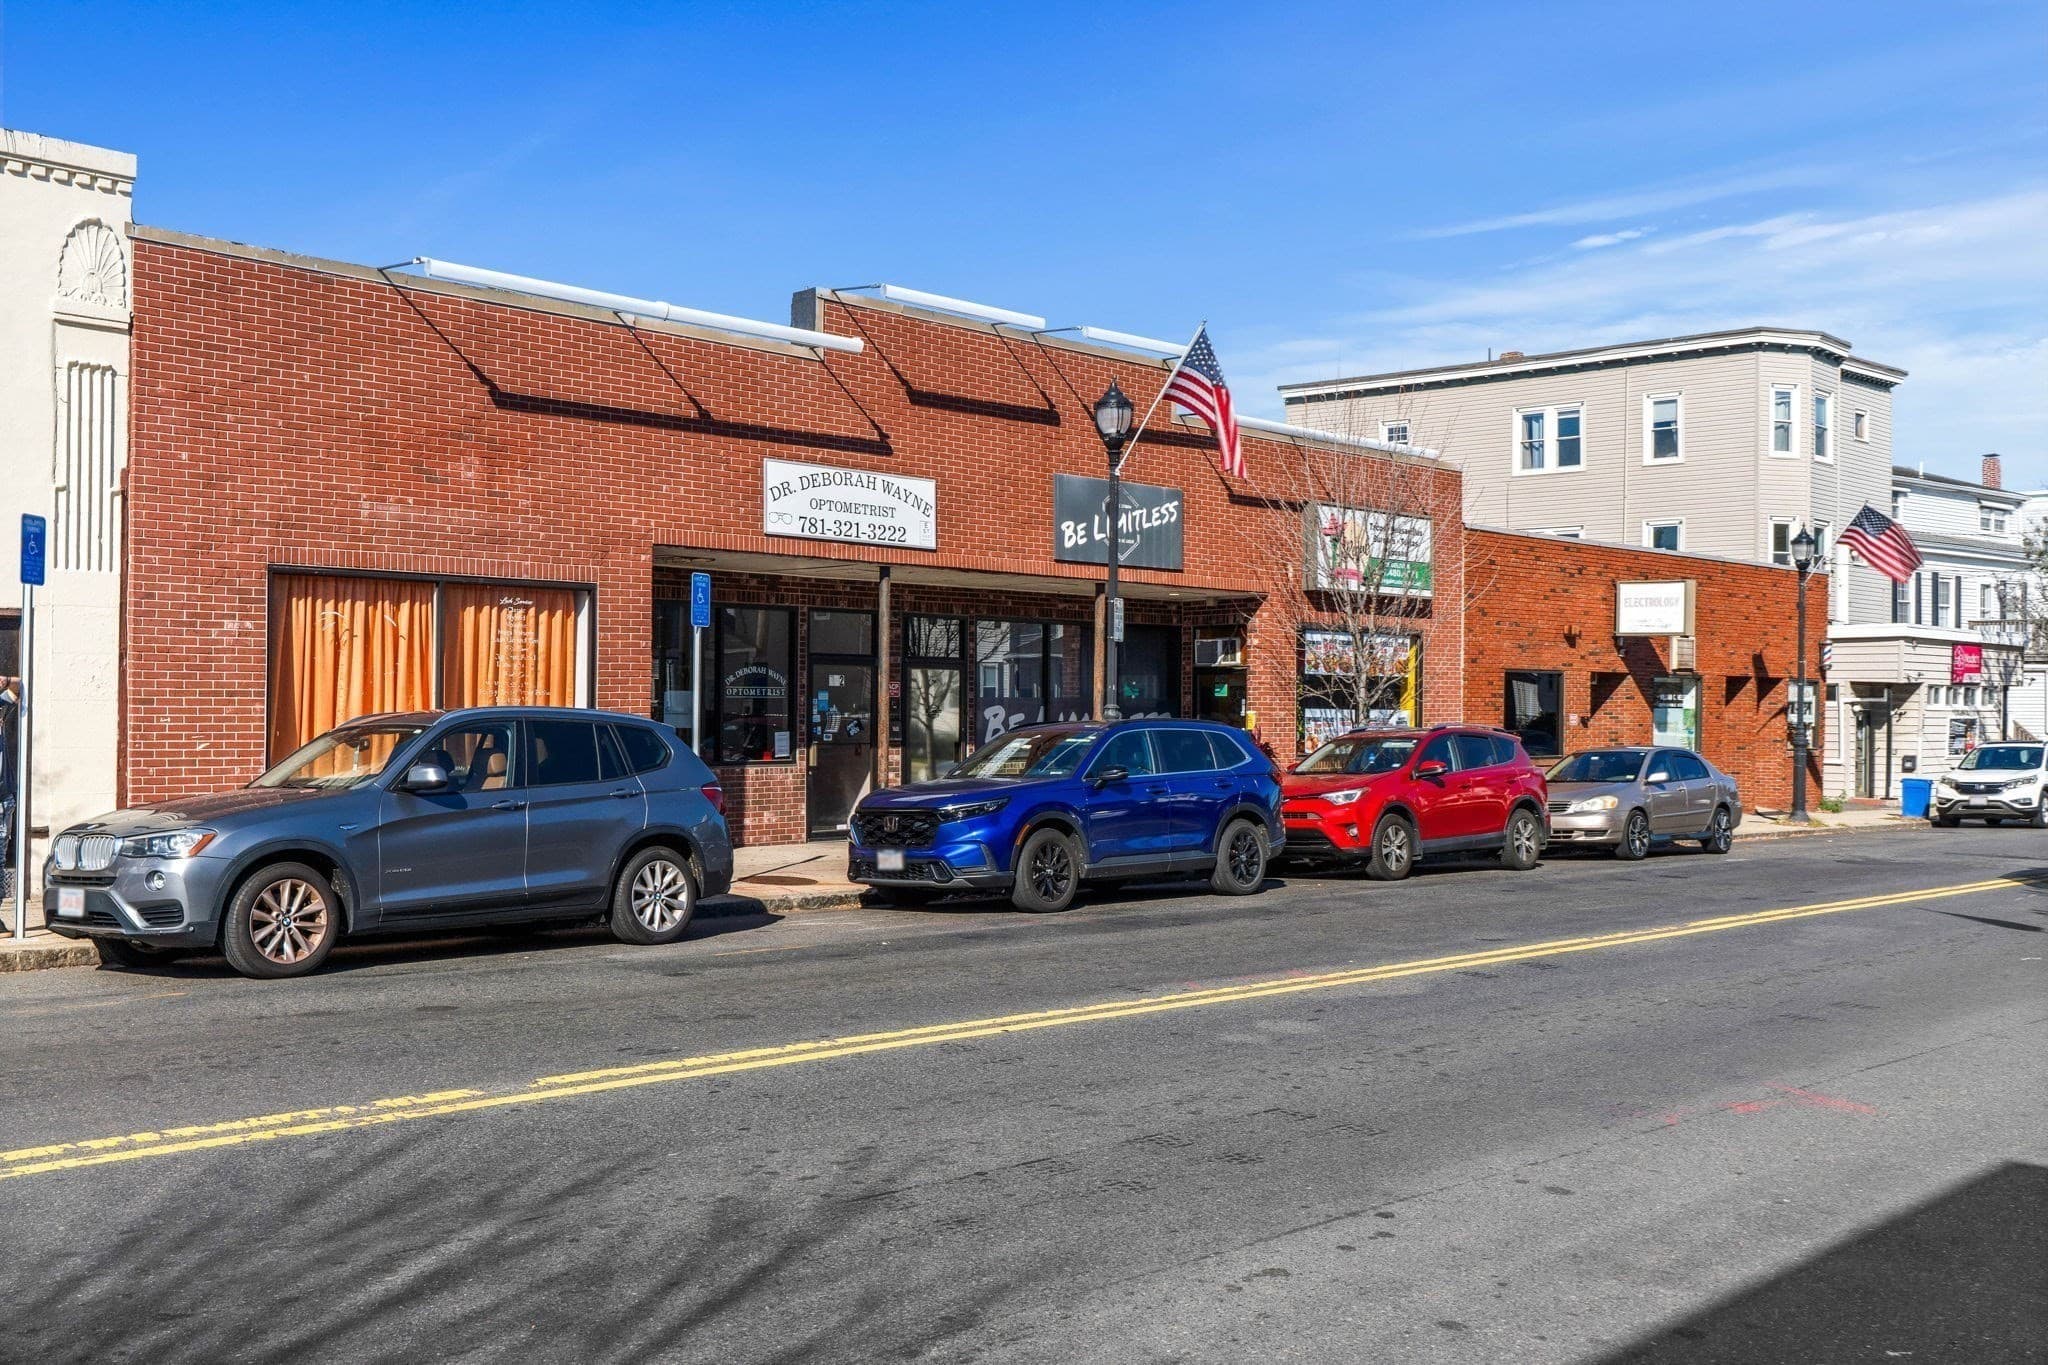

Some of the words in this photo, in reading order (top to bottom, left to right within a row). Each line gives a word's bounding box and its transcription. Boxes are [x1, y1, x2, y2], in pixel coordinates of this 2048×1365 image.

[768, 481, 797, 502] DR.
[798, 471, 877, 491] DEBORAH
[881, 479, 933, 518] WAYNE
[809, 498, 896, 519] OPTOMETRIST
[798, 516, 907, 544] 781-321-3222
[1060, 521, 1087, 549] BE
[735, 665, 767, 678] DEBORAH
[768, 669, 788, 686] WAYNE
[726, 688, 785, 696] OPTOMETRIST
